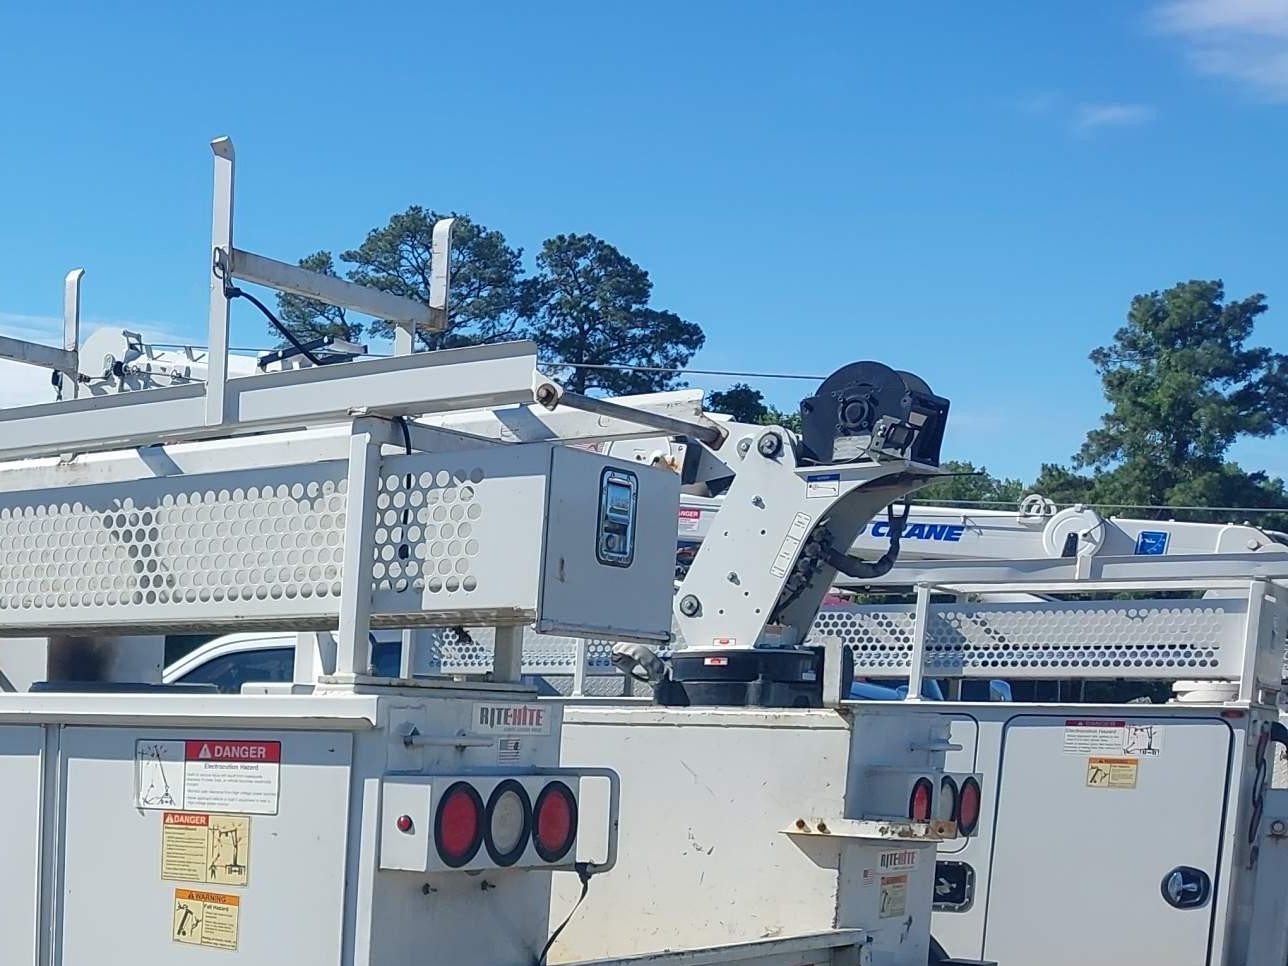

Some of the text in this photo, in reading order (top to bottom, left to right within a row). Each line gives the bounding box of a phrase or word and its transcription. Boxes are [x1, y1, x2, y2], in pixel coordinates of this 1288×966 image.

[214, 746, 266, 758] DANGER
[174, 813, 207, 824] DANGER
[195, 892, 227, 902] WARNING
